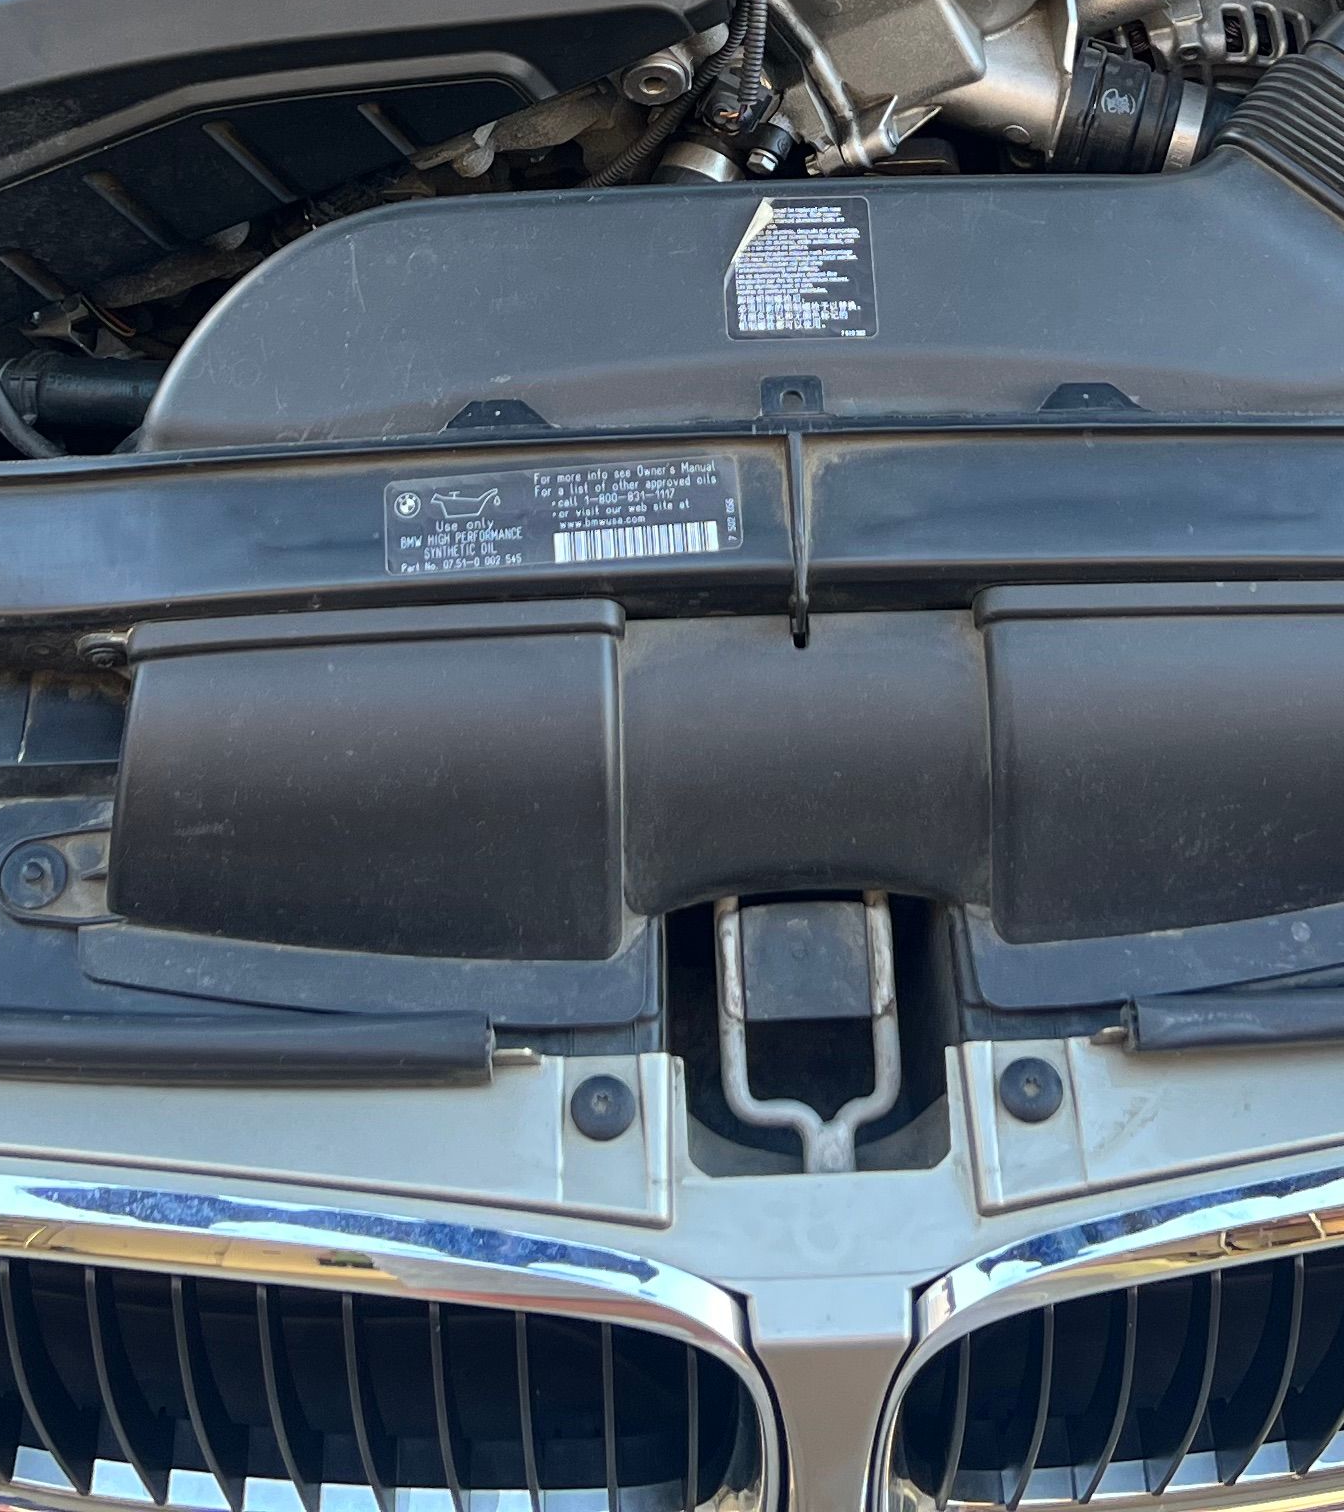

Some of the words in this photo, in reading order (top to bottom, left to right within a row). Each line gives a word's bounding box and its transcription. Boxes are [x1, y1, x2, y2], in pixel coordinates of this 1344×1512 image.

[534, 473, 551, 485] For
[557, 474, 581, 483] more
[587, 468, 608, 480] info
[614, 469, 631, 478] see
[637, 463, 675, 477] Owner's
[681, 460, 716, 473] Manual
[534, 485, 551, 497] For
[558, 488, 564, 496] a
[571, 483, 588, 495] list
[595, 482, 606, 493] of
[612, 478, 639, 491] other
[646, 475, 690, 492] approved
[697, 472, 717, 484] oils
[584, 488, 675, 505] 1-800-831-1117
[575, 505, 599, 517] visit
[606, 506, 621, 515] our
[628, 503, 648, 513] web
[653, 499, 673, 510] site
[679, 498, 690, 509] at
[436, 520, 457, 532] Use
[467, 517, 494, 530] only
[560, 515, 646, 530] www.bmwusa.com
[400, 536, 422, 549] BMW
[428, 532, 450, 546] HIGH
[455, 526, 523, 543] PERFORMANCE
[424, 544, 475, 560] SYNTHETIC
[481, 542, 497, 554] OIL
[401, 563, 420, 572] Part
[425, 561, 438, 571] No.
[485, 555, 500, 565] 002
[506, 553, 522, 563] 545
